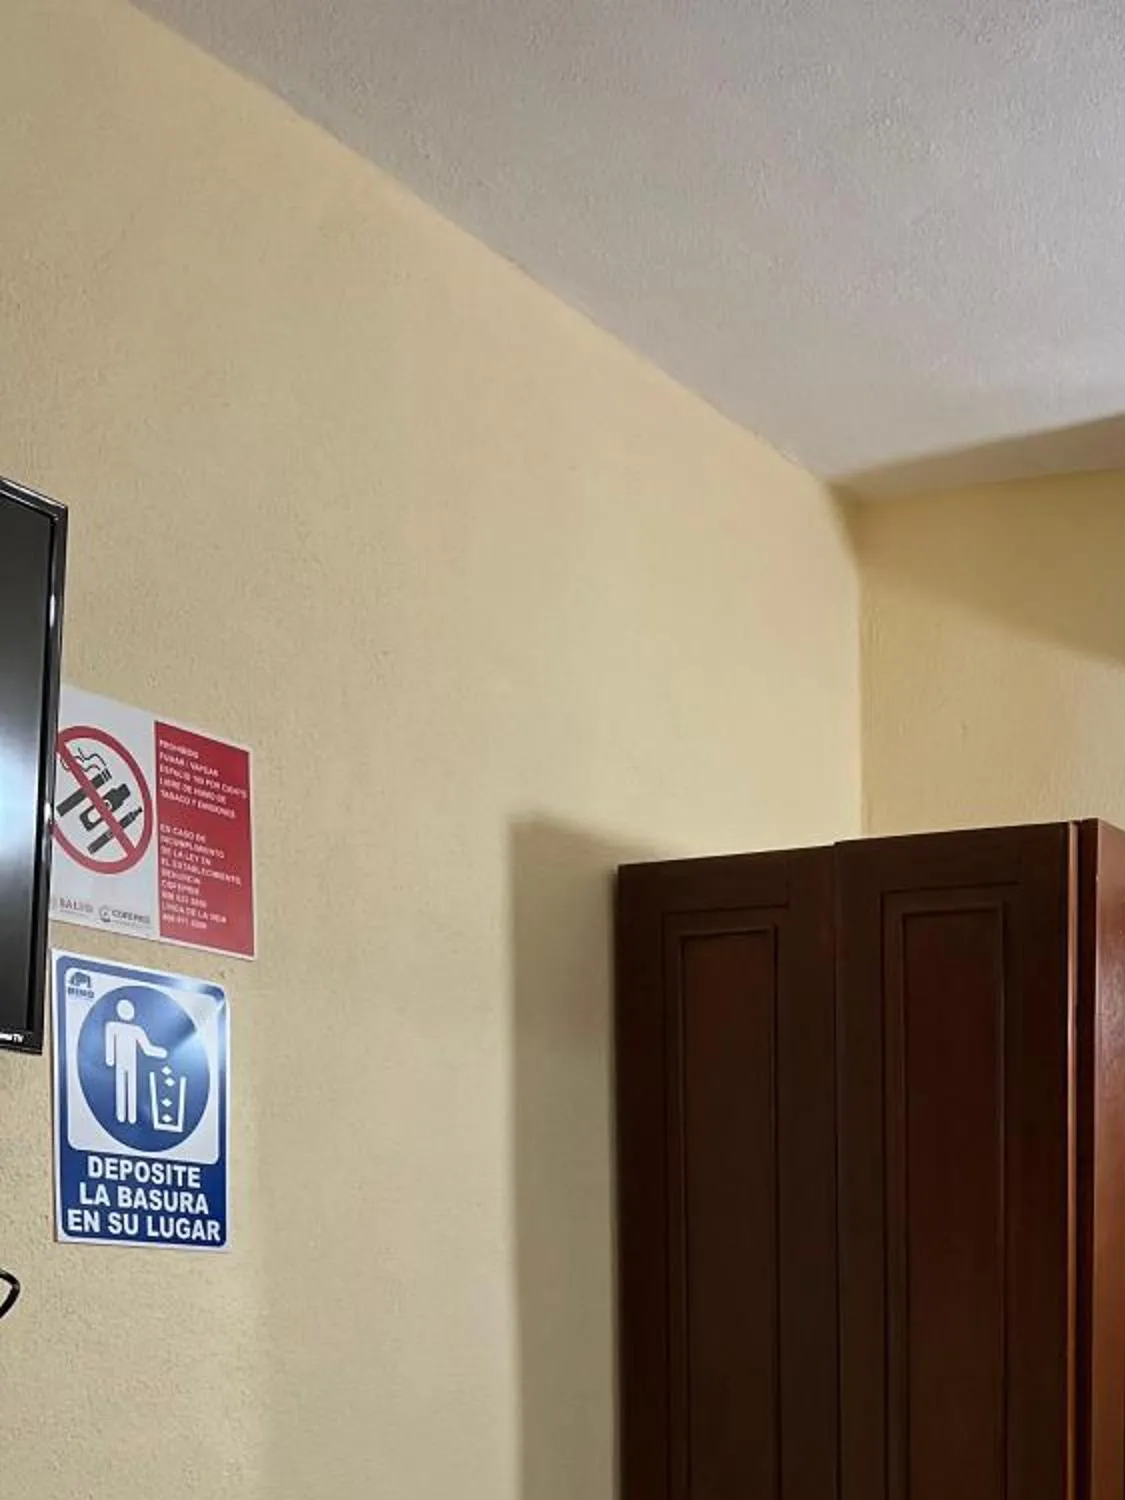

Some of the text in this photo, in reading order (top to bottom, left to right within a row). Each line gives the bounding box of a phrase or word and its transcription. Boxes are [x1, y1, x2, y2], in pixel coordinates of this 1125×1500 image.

[88, 1155, 201, 1189] DEPOSITE
[79, 1182, 209, 1215] LA BASURA
[67, 1209, 221, 1241] EN SU LUGAR
